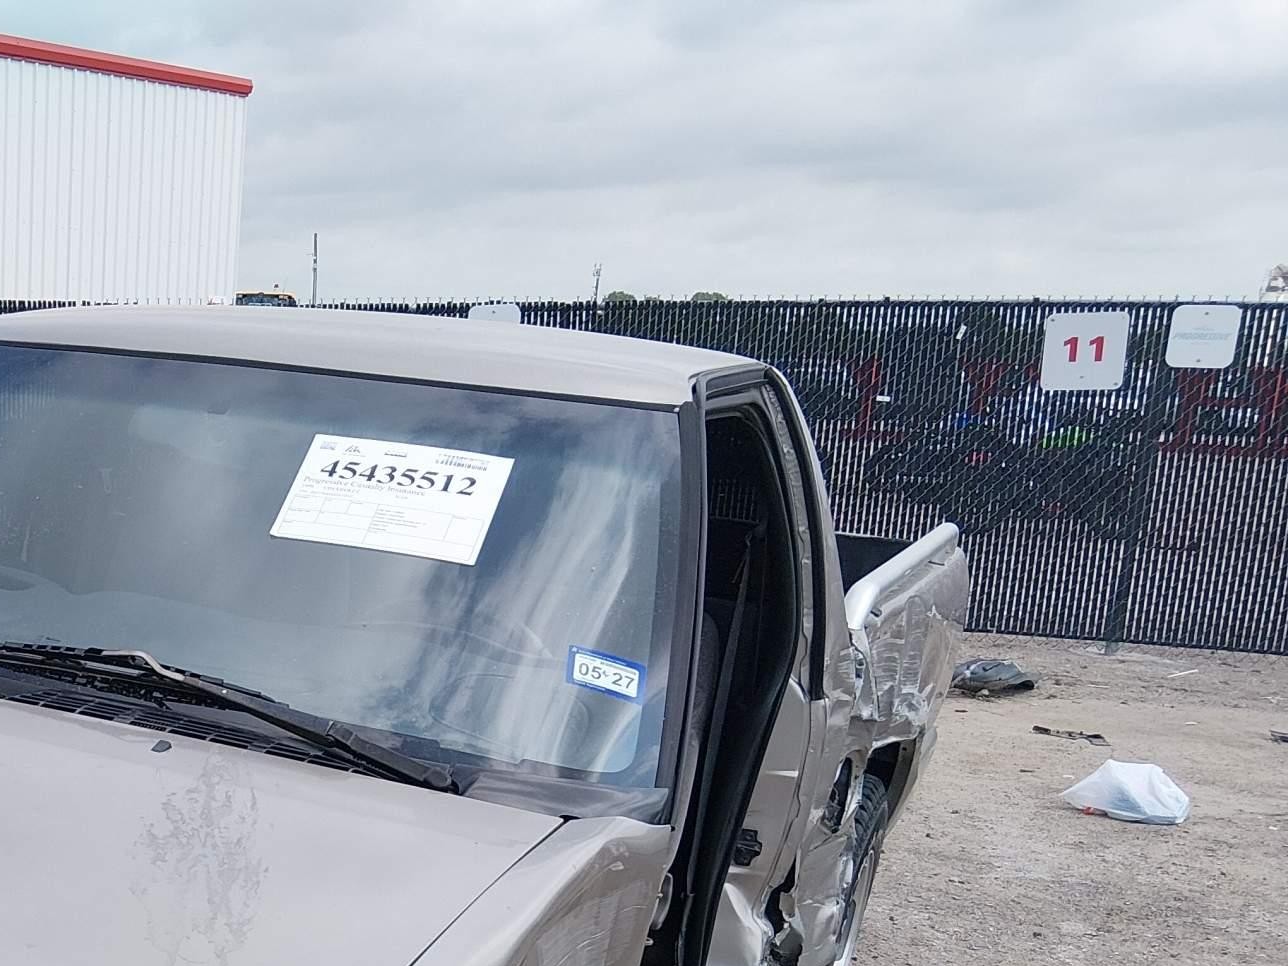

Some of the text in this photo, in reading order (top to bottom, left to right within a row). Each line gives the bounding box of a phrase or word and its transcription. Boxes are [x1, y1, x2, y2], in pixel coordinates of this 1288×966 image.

[1063, 336, 1105, 362] 11
[320, 459, 478, 496] 45435512
[578, 662, 602, 680] 05
[612, 672, 635, 689] 27
